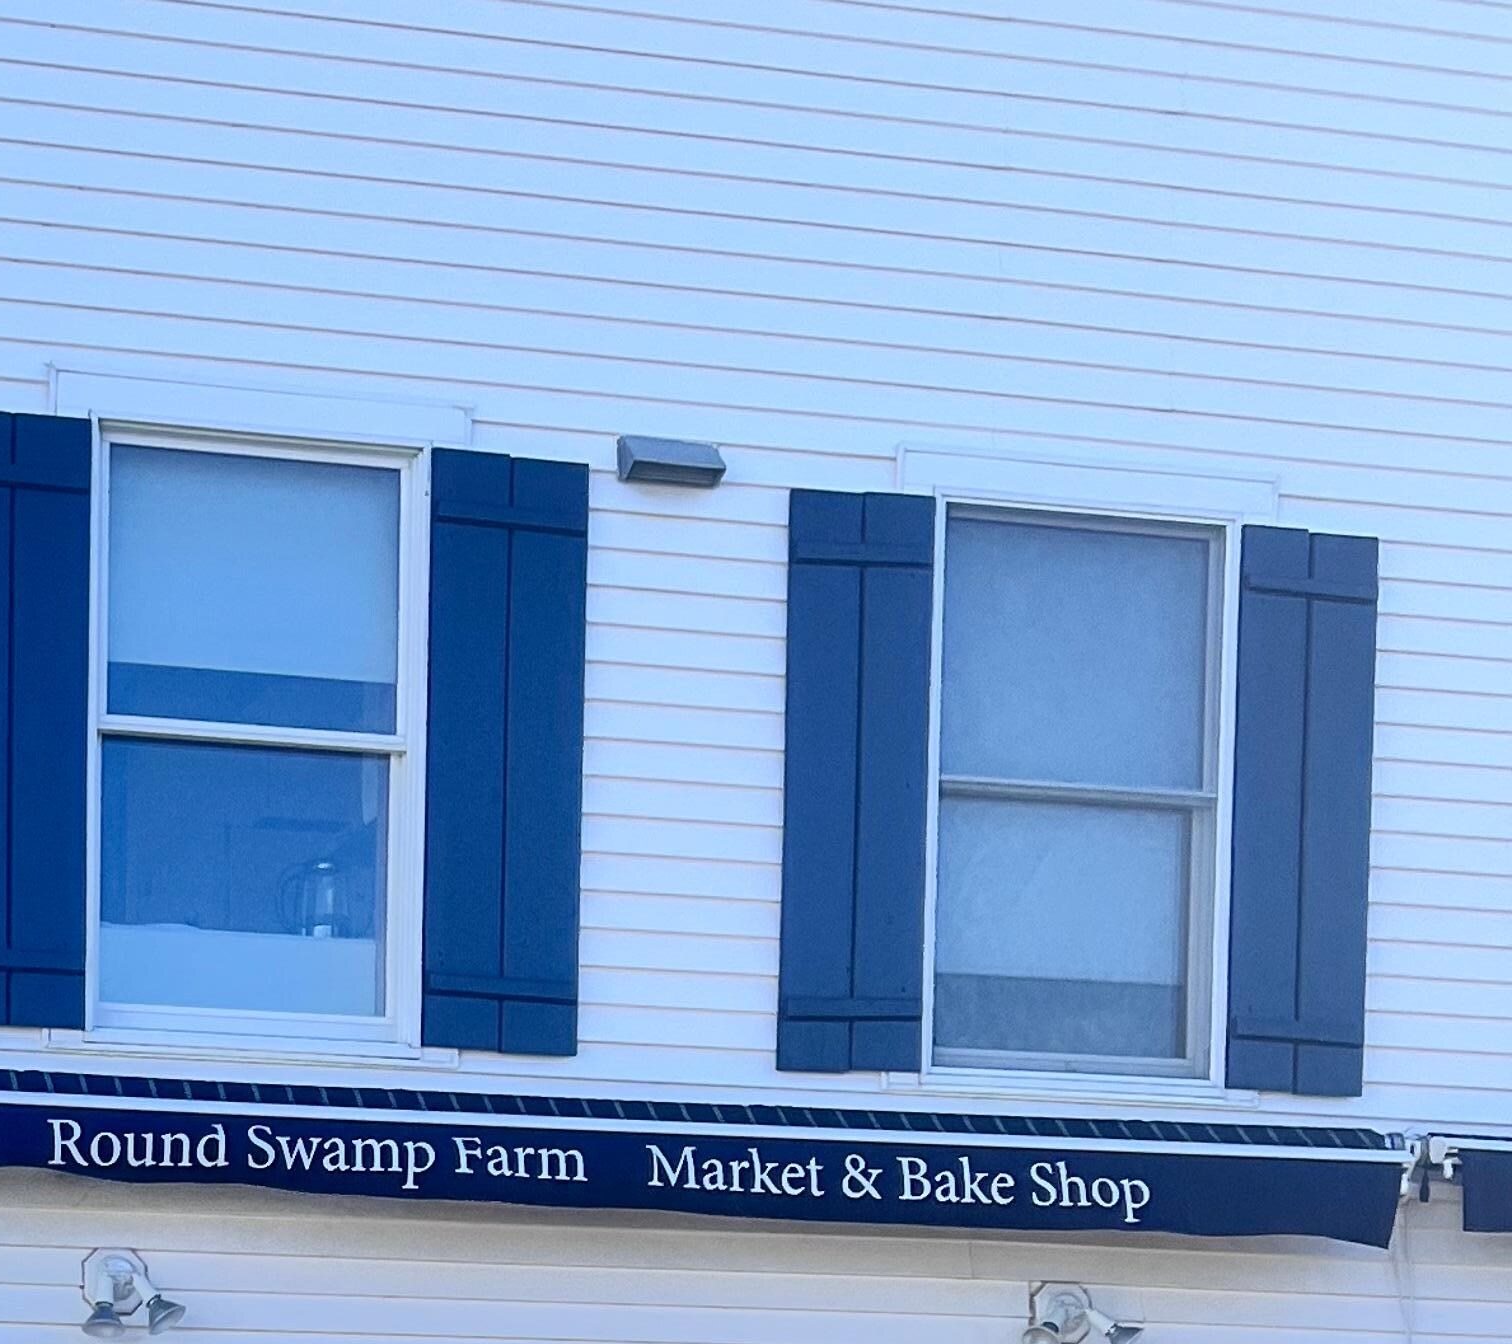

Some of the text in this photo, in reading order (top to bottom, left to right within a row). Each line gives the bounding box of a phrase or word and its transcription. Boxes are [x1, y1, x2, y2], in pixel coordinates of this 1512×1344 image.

[46, 1118, 1151, 1224] Round Swamp Farm Market & Bake Shop
